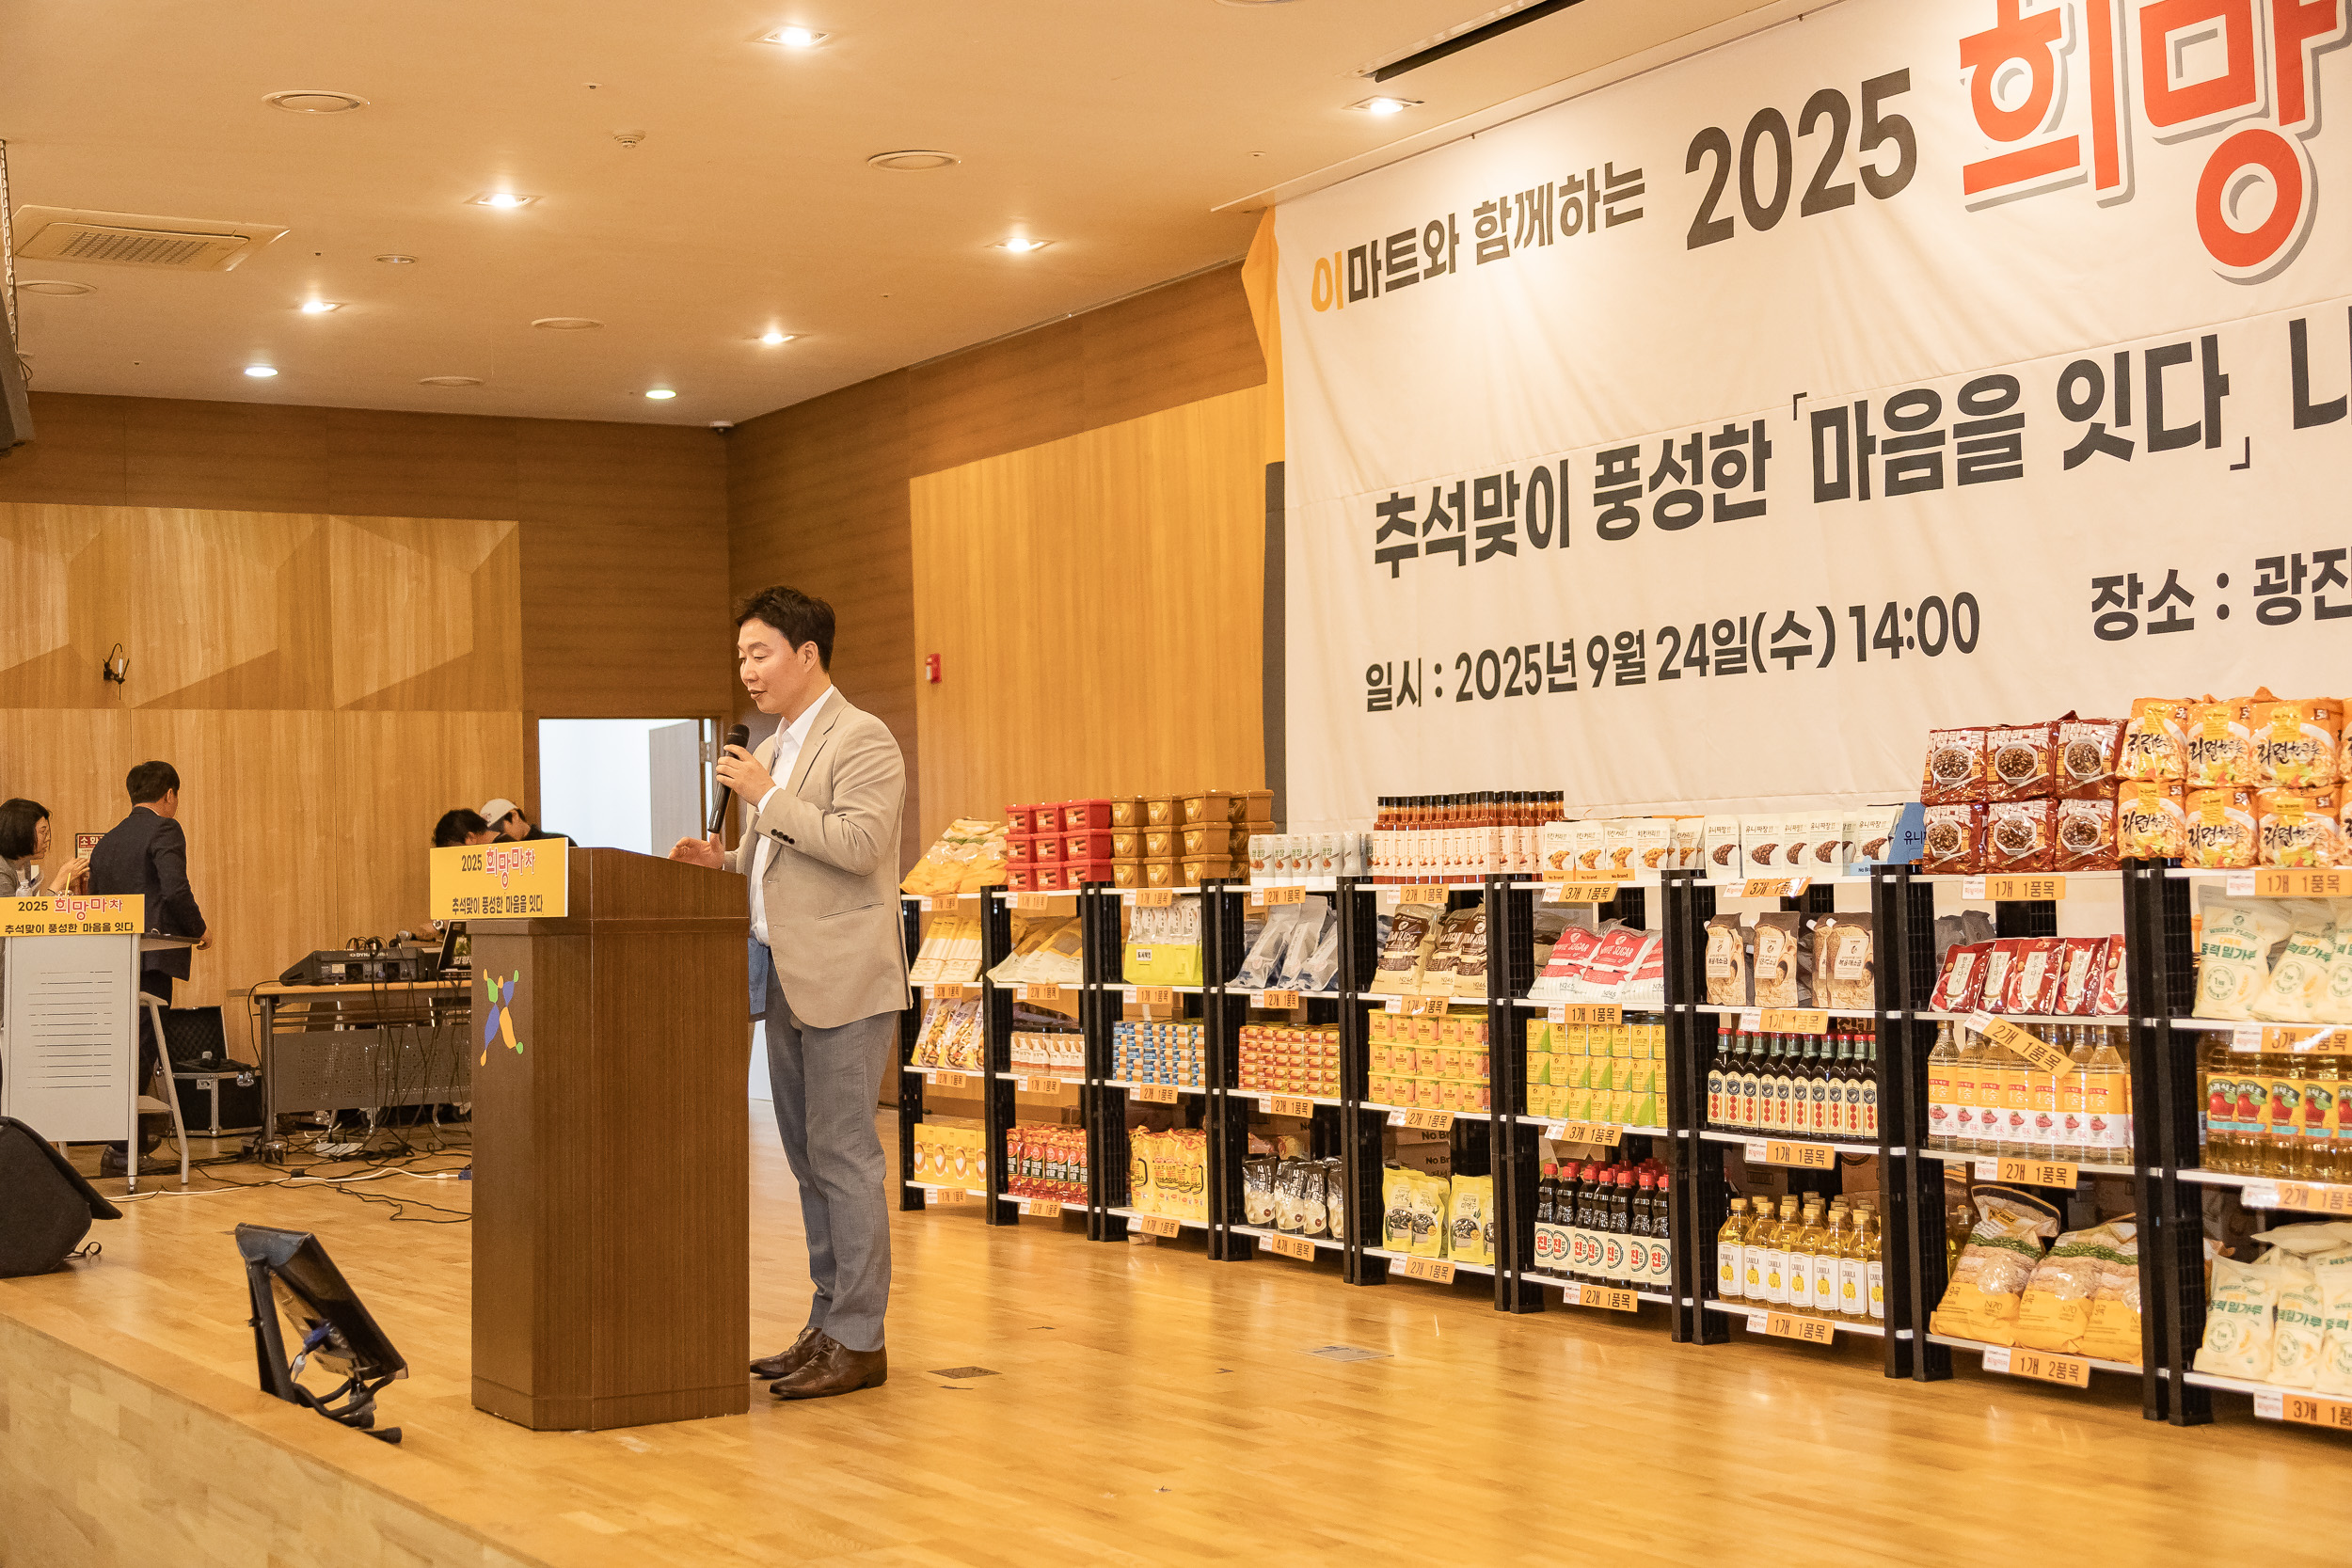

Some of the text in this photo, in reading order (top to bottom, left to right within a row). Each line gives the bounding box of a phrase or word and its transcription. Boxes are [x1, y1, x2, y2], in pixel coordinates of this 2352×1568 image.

[1313, 218, 1460, 314] 이마트와
[1473, 160, 1647, 265] 함께하는
[1686, 68, 1918, 250] 2025
[1373, 458, 1572, 579] 추석맞이
[1593, 419, 1772, 542] 풍성한
[2090, 566, 2196, 641] 장소
[1365, 661, 1423, 712] 일시
[1454, 633, 1578, 703] 2025년
[1586, 627, 1647, 688] 9월
[1656, 604, 1836, 681] 24일(수)
[1847, 592, 1980, 664] 14:00
[461, 847, 535, 889] 2025 희망마차
[1750, 881, 1767, 895] 3개
[1994, 880, 2055, 897] 1개 1품목
[2266, 875, 2289, 893] 1개
[2302, 875, 2341, 893] 1품목
[1284, 889, 1300, 902] 1품목
[1406, 889, 1419, 901] 2개
[1423, 888, 1443, 902] 1품목
[1565, 887, 1581, 900] 3개
[1587, 886, 1610, 900] 1품목
[18, 897, 122, 921] 2025 희망마차
[452, 894, 543, 915] 추석맞이 풍성한 마음을 잇다
[5, 922, 134, 934] 추석맞이 풍성한 마음을 잇다
[1567, 942, 1590, 952] SUGAR
[1613, 946, 1634, 958] SUGAR
[2221, 945, 2257, 961] 밀가루
[1283, 992, 1297, 1007] 1품목
[1424, 1000, 1443, 1014] 1품목
[1572, 1008, 1615, 1022] 1개 1품목
[1769, 1015, 1820, 1030] 1개 1품목
[1992, 1024, 2062, 1071] 2개 1품목
[2271, 1032, 2296, 1050] 3개
[1158, 1088, 1173, 1101] 1품목
[1275, 1100, 1308, 1117] 2개 1품목
[1408, 1112, 1448, 1129] 2개 1품목
[1422, 1131, 1437, 1140] No
[1568, 1126, 1614, 1144] 3개 1품목
[1775, 1146, 1825, 1165] 1개 1품목
[2006, 1163, 2068, 1185] 2개 1품목
[2283, 1188, 2309, 1208] 2개
[1161, 1221, 1174, 1235] 1품목
[1276, 1239, 1309, 1259] 4개 1품목
[1537, 1236, 1548, 1251] 진
[1651, 1252, 1661, 1268] 진
[1410, 1260, 1449, 1280] 2개 1품목
[1586, 1290, 1630, 1308] 2개 1품목
[1774, 1319, 1825, 1340] 1개 1품목
[2020, 1356, 2079, 1382] 1개 2품목
[2293, 1400, 2317, 1421] 3개
